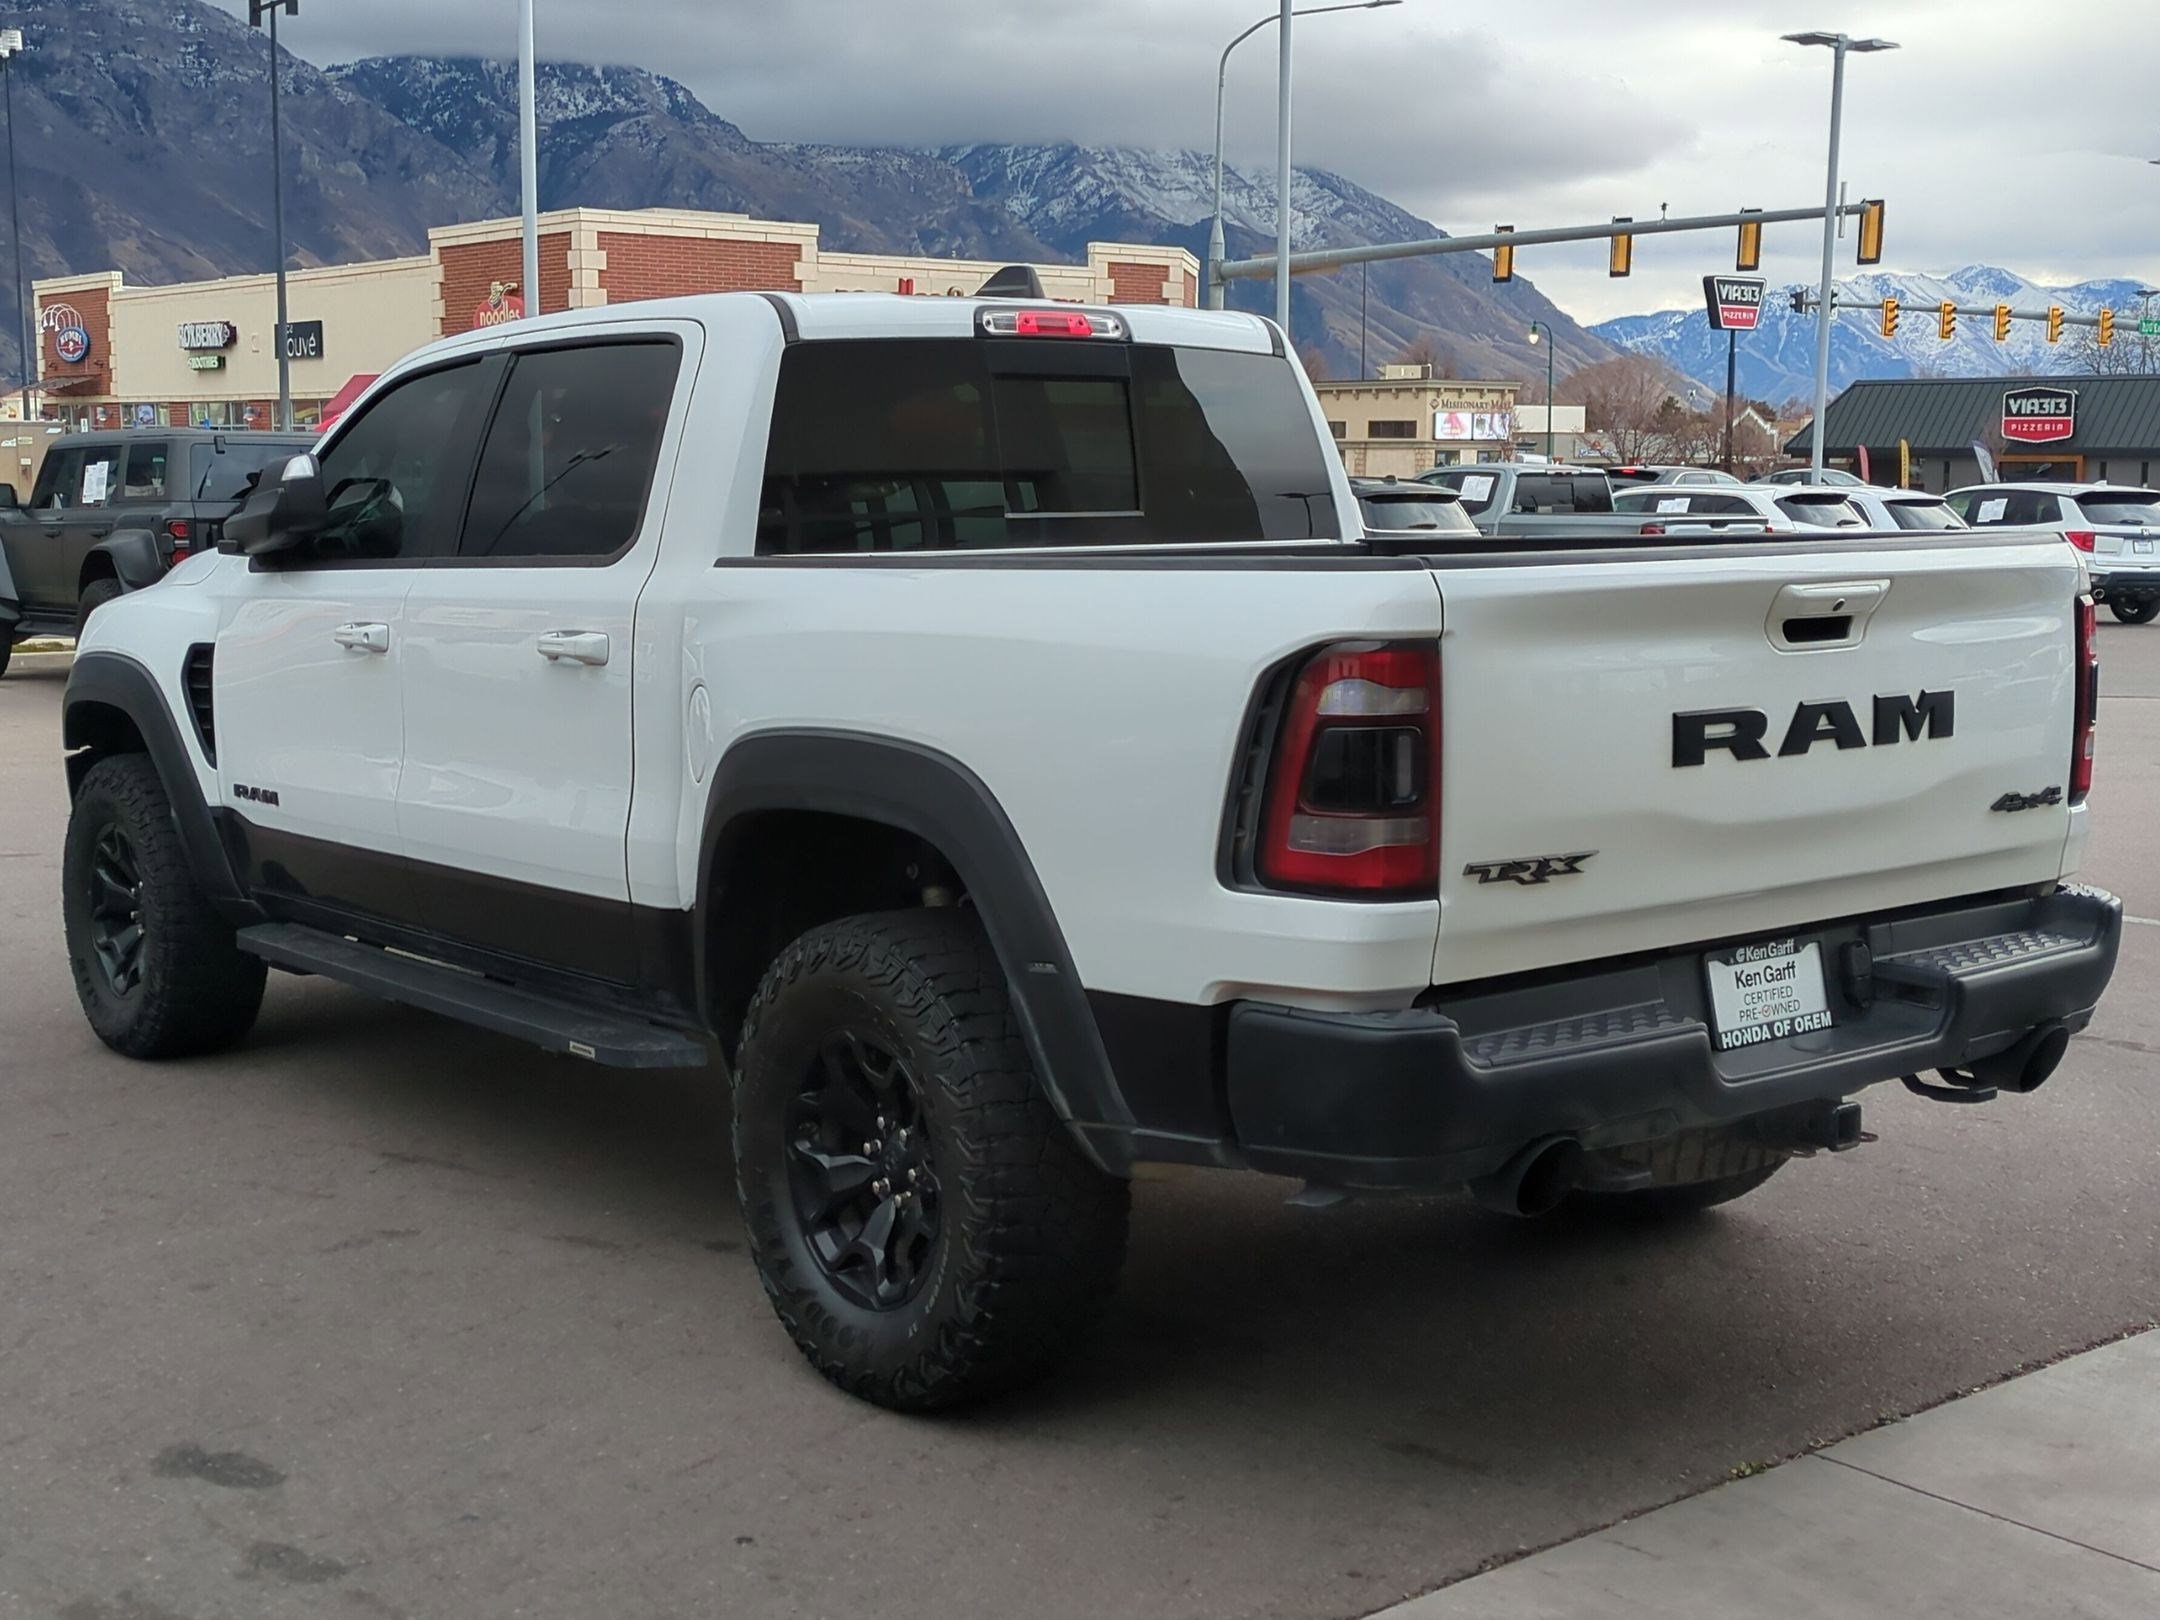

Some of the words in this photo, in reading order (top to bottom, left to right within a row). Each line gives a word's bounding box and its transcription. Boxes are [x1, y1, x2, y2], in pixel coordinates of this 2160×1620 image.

[480, 300, 520, 326] noodles
[2011, 424, 2064, 432] PIZZERIA
[1672, 689, 1955, 768] RAM
[233, 783, 279, 806] RAM
[1462, 850, 1600, 885] TRX
[1735, 969, 1762, 989] Ken
[1763, 961, 1796, 983] Garff
[1744, 985, 1793, 1006] CERTIFIED
[1721, 1024, 1771, 1049] HONDA
[1773, 1020, 1791, 1037] OF
[1795, 1011, 1832, 1033] OREM
